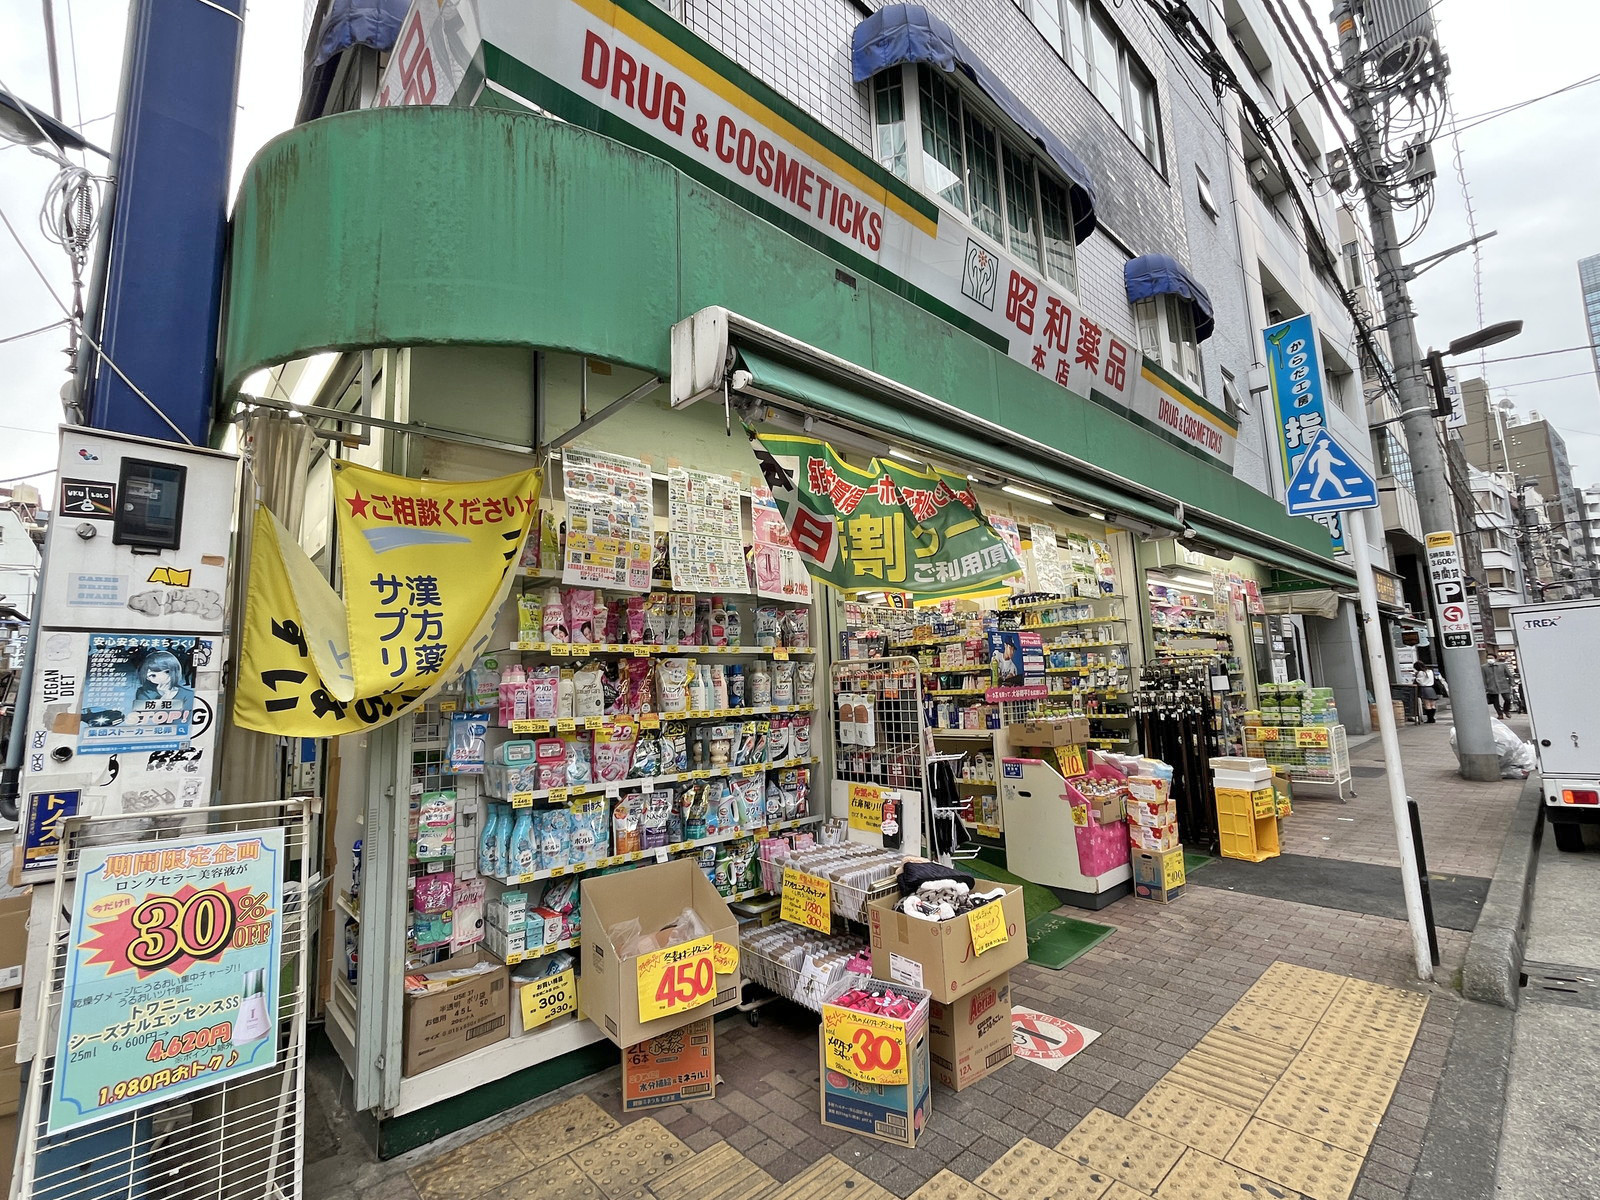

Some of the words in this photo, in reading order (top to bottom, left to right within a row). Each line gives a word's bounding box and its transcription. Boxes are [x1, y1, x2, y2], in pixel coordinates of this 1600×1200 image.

[580, 28, 688, 137] DRUG
[690, 112, 711, 152] &
[716, 114, 883, 253] COSMETICKS
[1005, 269, 1128, 393] 昭和薬品
[1031, 343, 1071, 388] 本店
[1288, 337, 1312, 408] からだ工房
[1158, 397, 1179, 430] DRUG
[1178, 415, 1184, 431] &
[1183, 413, 1223, 455] COSMETICKS
[370, 494, 525, 527] ご相談ください
[1428, 535, 1451, 543] Times
[1428, 550, 1456, 560] 5時間最大
[1431, 568, 1460, 580] 時間貸
[1437, 583, 1460, 604] P
[370, 573, 409, 678] サプリ
[405, 574, 448, 677] 漢方薬
[1524, 619, 1558, 629] TREX
[93, 636, 196, 648] 安心安全なまちづくり
[43, 669, 60, 704] VEGAN
[60, 673, 75, 699] DIET
[125, 710, 190, 726] STOP!
[144, 700, 172, 710] 防犯
[87, 727, 172, 737] 集団ストーカー犯罪
[102, 839, 262, 881] 期間限定企画
[116, 863, 248, 892] ロングセラー美容液が
[92, 898, 131, 915] 今だけ!!
[126, 888, 237, 971] 30
[233, 921, 274, 951] OFF
[72, 963, 242, 1009] 乾燥ダメージにうるおい集中チャージ!!
[655, 957, 714, 1008] 450
[131, 997, 191, 1020] トワニー
[439, 1000, 461, 1013] 半透明
[538, 990, 565, 1010] 300
[550, 1003, 569, 1016] 330
[68, 995, 240, 1050] シーズナルエッセンスSS
[70, 1046, 98, 1064] 25ml
[852, 1028, 902, 1072] 30
[1012, 1046, 1065, 1060] 路上喫
